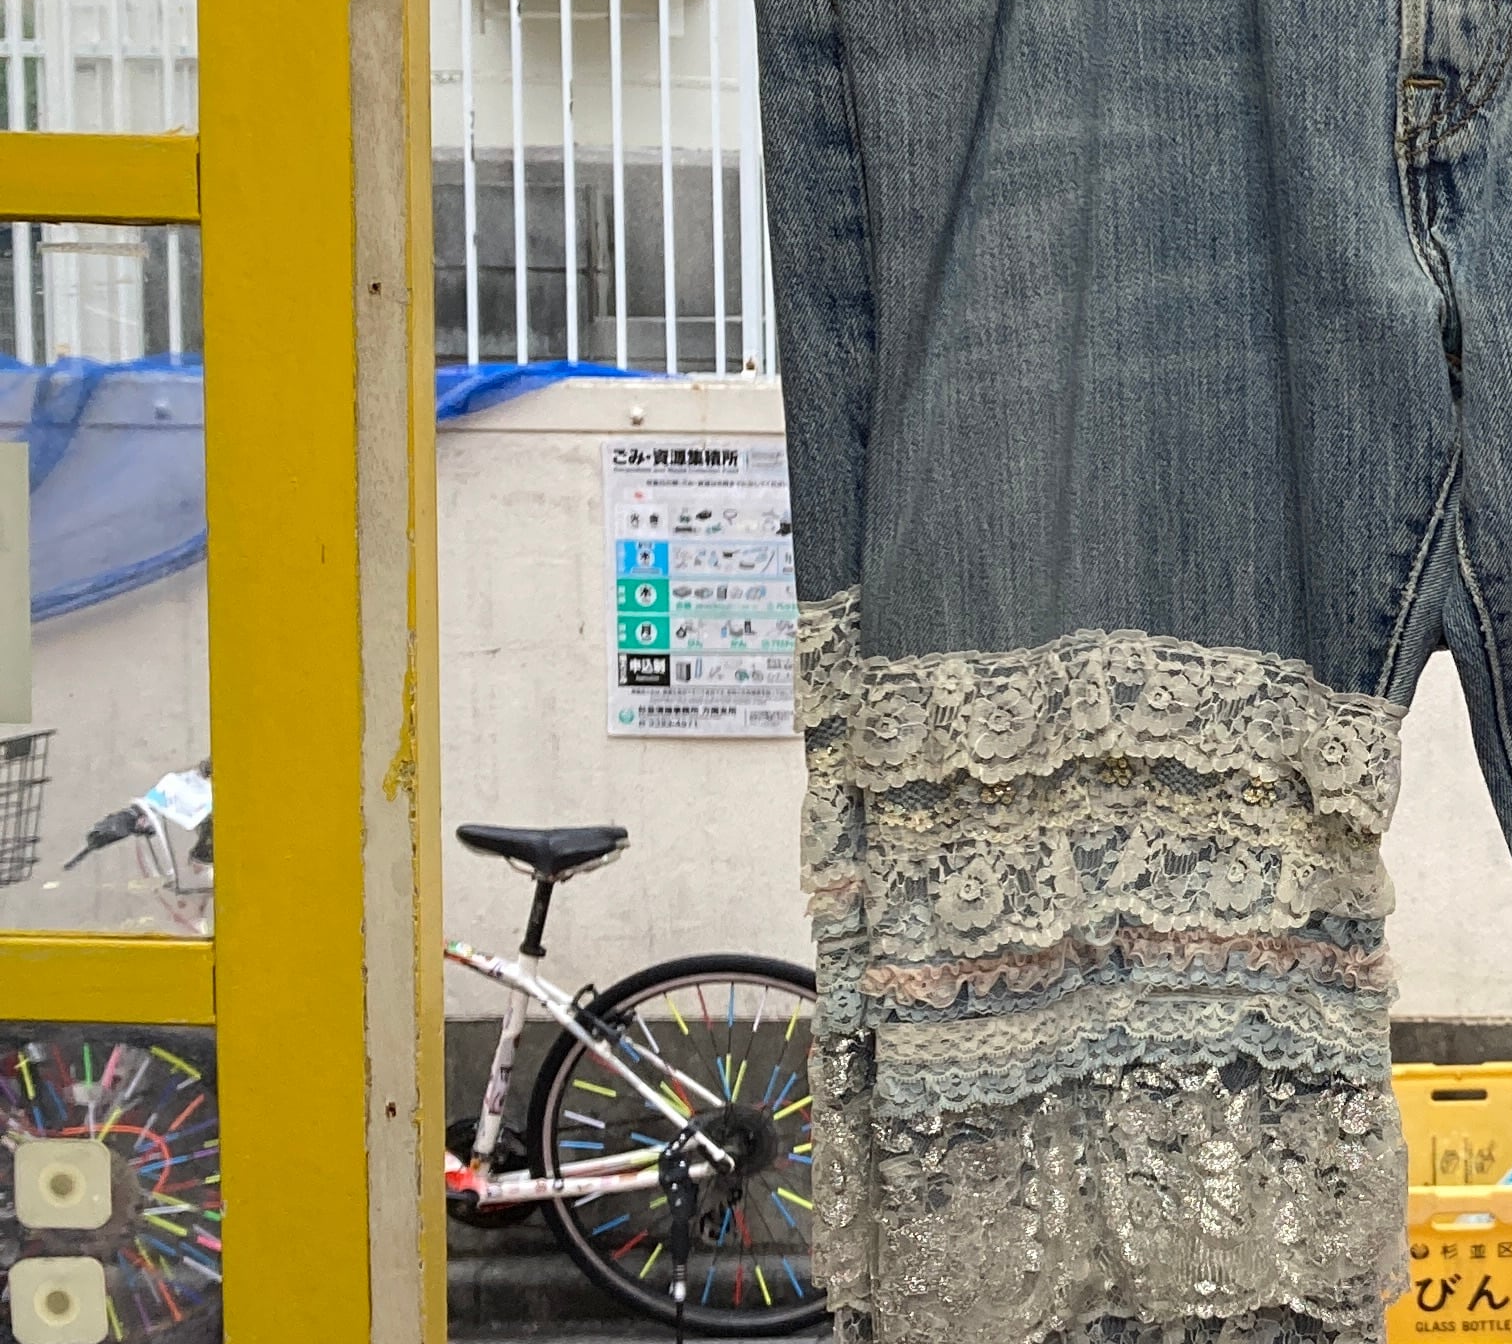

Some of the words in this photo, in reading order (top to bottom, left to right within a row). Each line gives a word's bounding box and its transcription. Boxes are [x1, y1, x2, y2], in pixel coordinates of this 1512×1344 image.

[1415, 1273, 1510, 1313] びん
[1415, 1320, 1456, 1333] GLASS
[1462, 1319, 1512, 1332] BOTTLE
